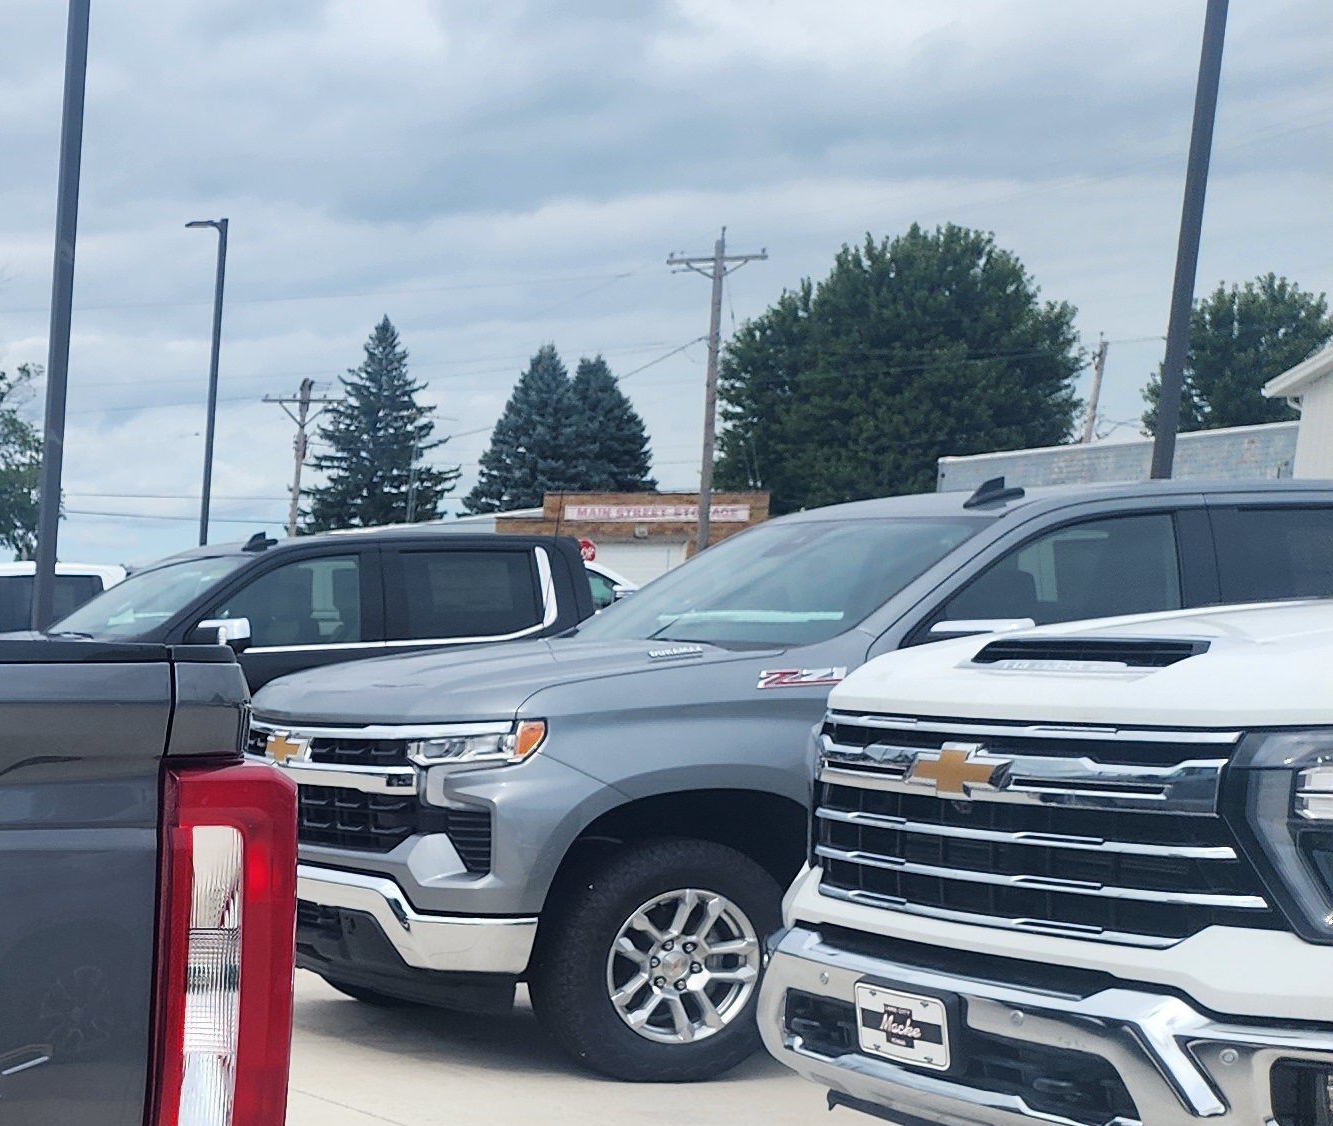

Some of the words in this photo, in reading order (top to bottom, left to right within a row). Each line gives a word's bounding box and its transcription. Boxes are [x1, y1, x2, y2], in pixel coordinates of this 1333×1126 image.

[576, 507, 610, 519] MAIN
[616, 507, 666, 518] STREET
[672, 506, 739, 518] STOAGE
[879, 1013, 922, 1039] Macke
